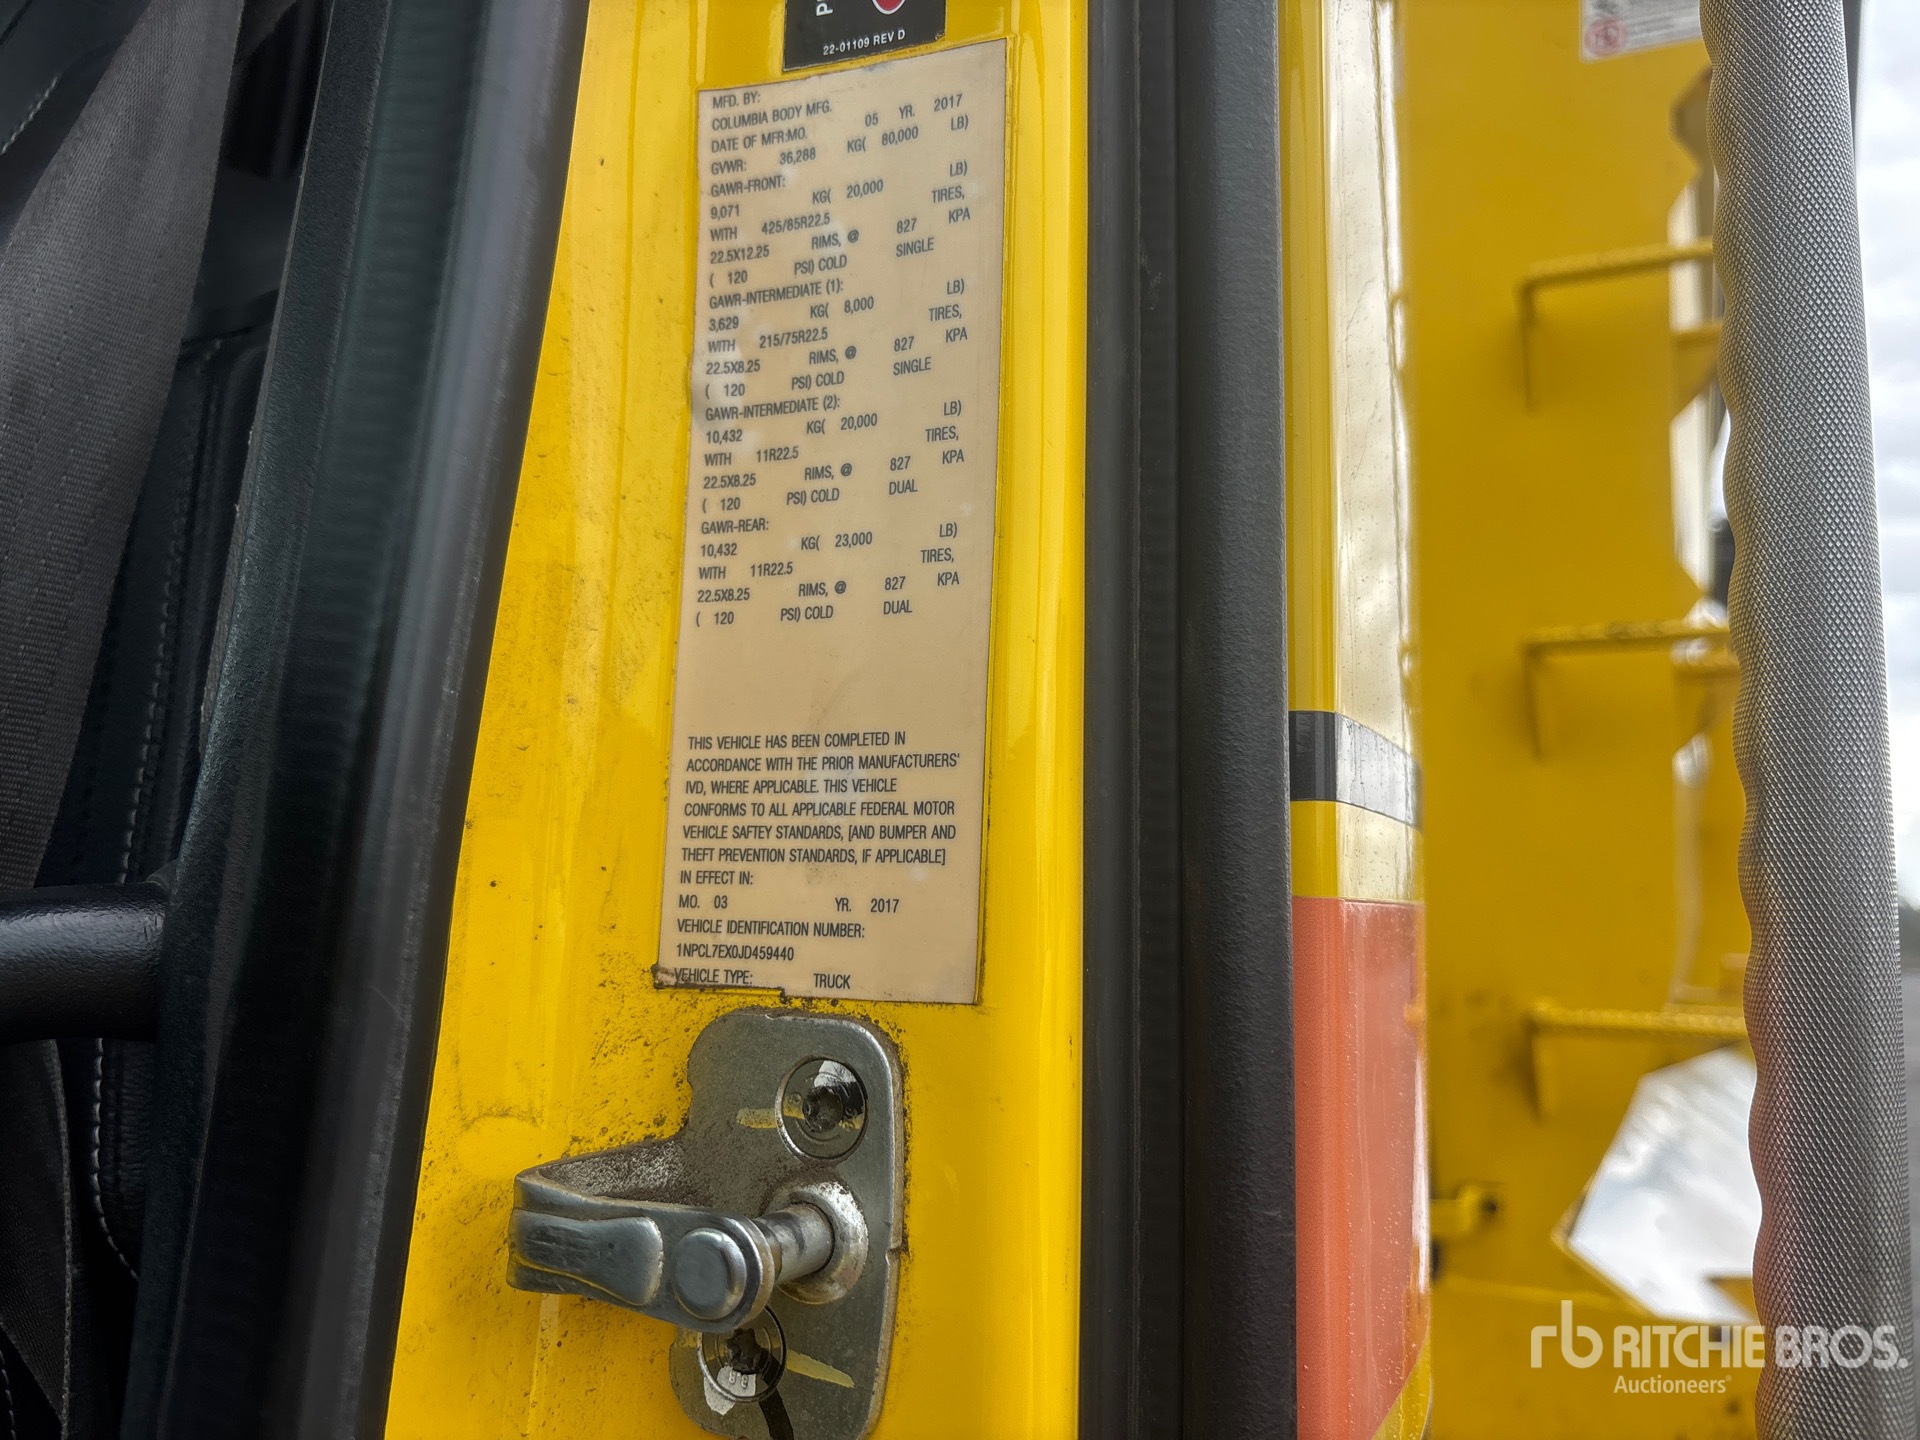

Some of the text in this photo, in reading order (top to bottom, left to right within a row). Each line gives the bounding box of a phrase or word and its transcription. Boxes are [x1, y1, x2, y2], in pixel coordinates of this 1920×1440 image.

[816, 0, 834, 16] P
[823, 29, 905, 56] 22-01109 REV D
[712, 91, 760, 109] MFD. BY:
[711, 137, 738, 153] DATE
[743, 135, 757, 149] OF
[865, 113, 879, 127] 05
[899, 104, 915, 120] YR.
[934, 94, 962, 112] 2017
[712, 100, 832, 131] COLUMBIA BODY MFG.
[711, 114, 968, 175] GVWR: 36,288 KG( 80,000 LB)
[711, 177, 785, 197] GAWR-FRONT:
[711, 160, 968, 220] 9,071 KG( 20,000 LB)
[710, 186, 965, 242] WITH 425/85R22.5 TIRES,
[710, 209, 970, 264] 22.5X12.25 RIMS, @ 827 KPA
[728, 270, 748, 285] 120
[794, 260, 814, 276] PSI)
[818, 254, 847, 271] COLD
[896, 238, 934, 258] SINGLE
[709, 279, 965, 332] 3,629 KG( 8,000 LB)
[710, 279, 843, 309] GAWR-INTERMEDIATE (1):
[708, 305, 962, 353] WITH 215/75R22.5 TIRES,
[706, 327, 968, 375] 22.5X8.25 RIMS, @ 827 KPA
[724, 383, 745, 397] 120
[792, 376, 812, 391] PSI)
[816, 371, 844, 387] COLD
[893, 357, 931, 376] SINGLE
[706, 396, 840, 421] GAWR-INTERMEDIATE (2):
[706, 400, 962, 444] 10,432 KG( 20,000 LB)
[705, 426, 959, 466] WITH 11R22.5 TIRES,
[704, 449, 964, 489] 22.5X8.25 RIMS, @ 827 KPA
[720, 498, 740, 511] 120
[787, 492, 807, 506] PSI)
[811, 488, 840, 502] COLD
[889, 479, 918, 495] DUAL
[701, 522, 958, 558] 10,432 KG( 23,000 LB)
[702, 518, 769, 534] GAWR-REAR:
[699, 548, 954, 579] WITH 11R22.5 TIRES,
[698, 572, 959, 602] 22.5X8.25 RIMS, @ 827 KPA
[714, 612, 734, 624] 120
[781, 608, 800, 622] PSI)
[805, 606, 833, 620] COLD
[883, 600, 912, 614] DUAL
[688, 731, 906, 750] THIS VEHICLE HAS BEEN COMPLETED IN
[686, 754, 960, 772] ACCORDANCE WITH THE PRIOR MANUFACTURERS'
[686, 778, 897, 796] IVD, WHERE APPLICABLE. THIS VEHICLE
[684, 800, 954, 817] CONFORMS TO ALL APPLICABLE FEDERAL MOTOR
[683, 824, 956, 842] VEHICLE SAFTEY STANDARDS, [AND BUMPER AND
[682, 848, 946, 865] THEFT PREVENTION STANDARDS, IF APPLICABLE]
[680, 870, 753, 884] IN EFFECT IN:
[679, 895, 899, 913] MO. 03 YR. 2017
[678, 919, 865, 938] VEHICLE IDENTIFICATION NUMBER:
[677, 943, 794, 961] 1NPCL7EX0JD459440
[674, 968, 850, 989] VEHICLE TYPE: TRUCK
